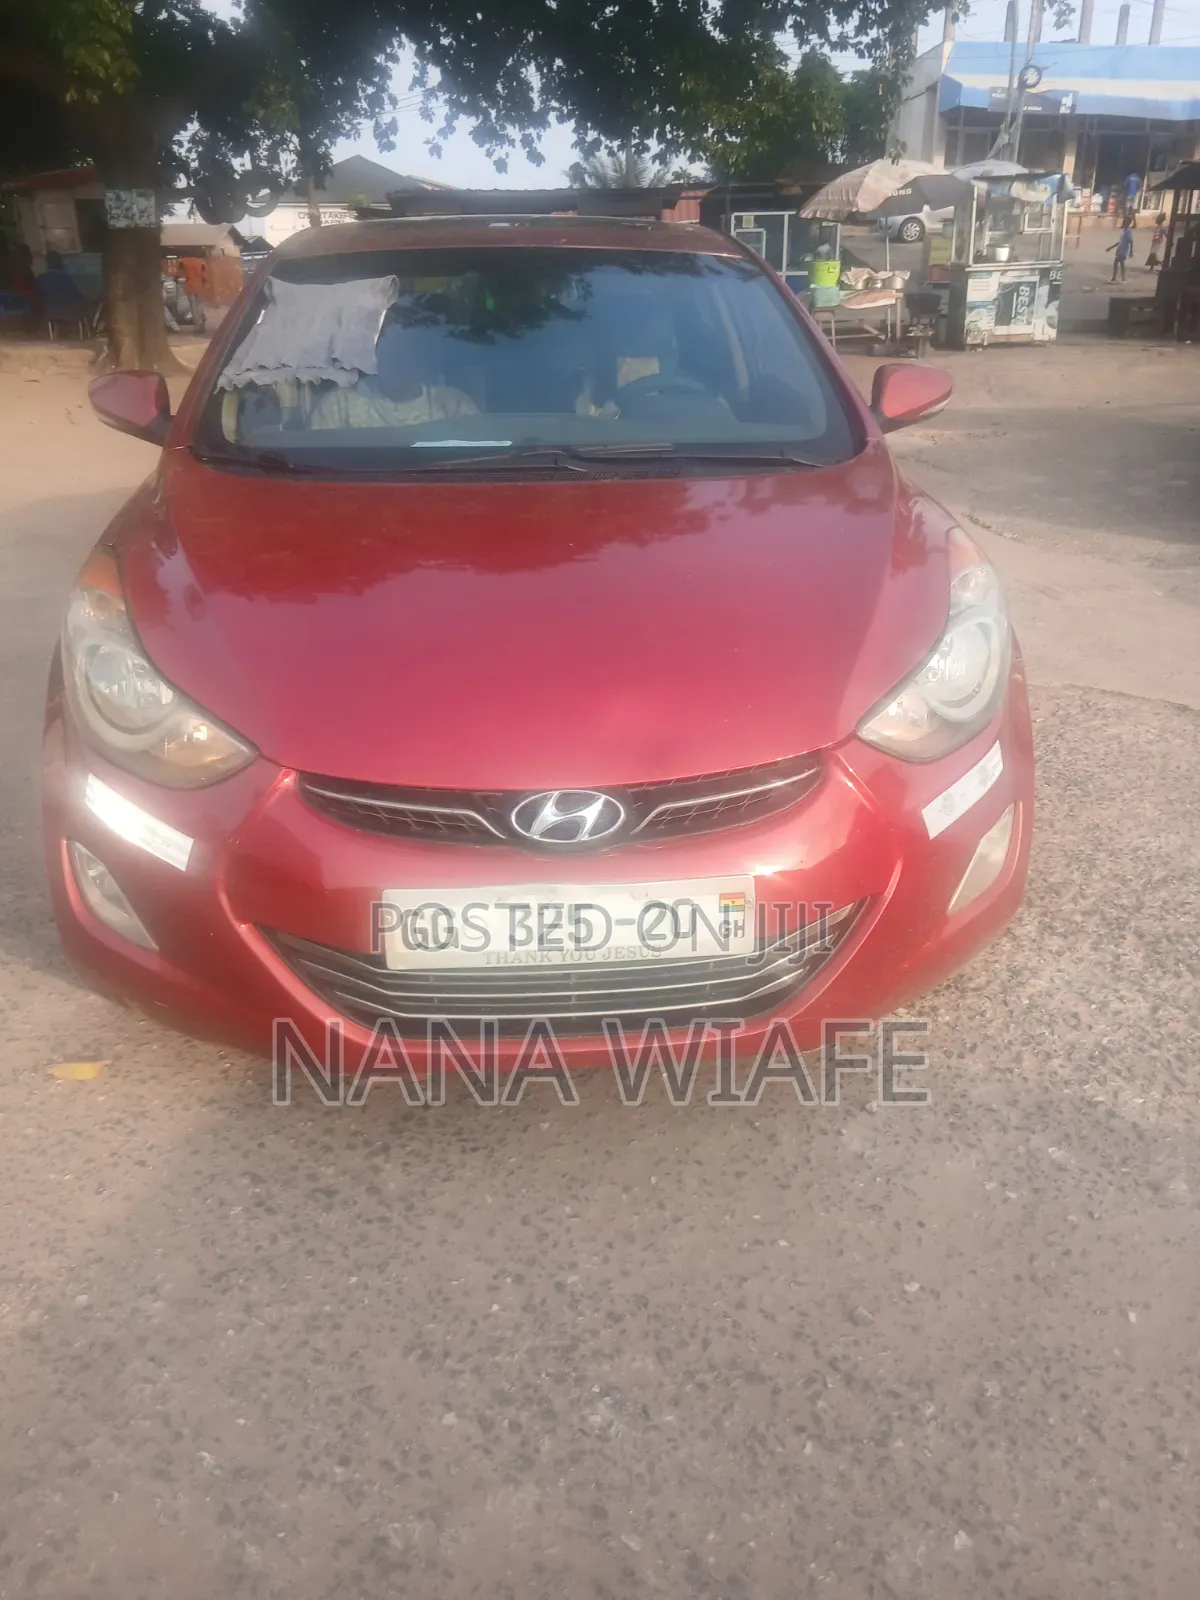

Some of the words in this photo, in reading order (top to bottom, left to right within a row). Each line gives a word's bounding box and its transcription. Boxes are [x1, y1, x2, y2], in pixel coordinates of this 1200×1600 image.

[1017, 286, 1031, 324] BEST
[718, 918, 745, 939] GH
[484, 950, 553, 966] THANK
[560, 948, 595, 963] YOU
[602, 943, 662, 961] JESUS
